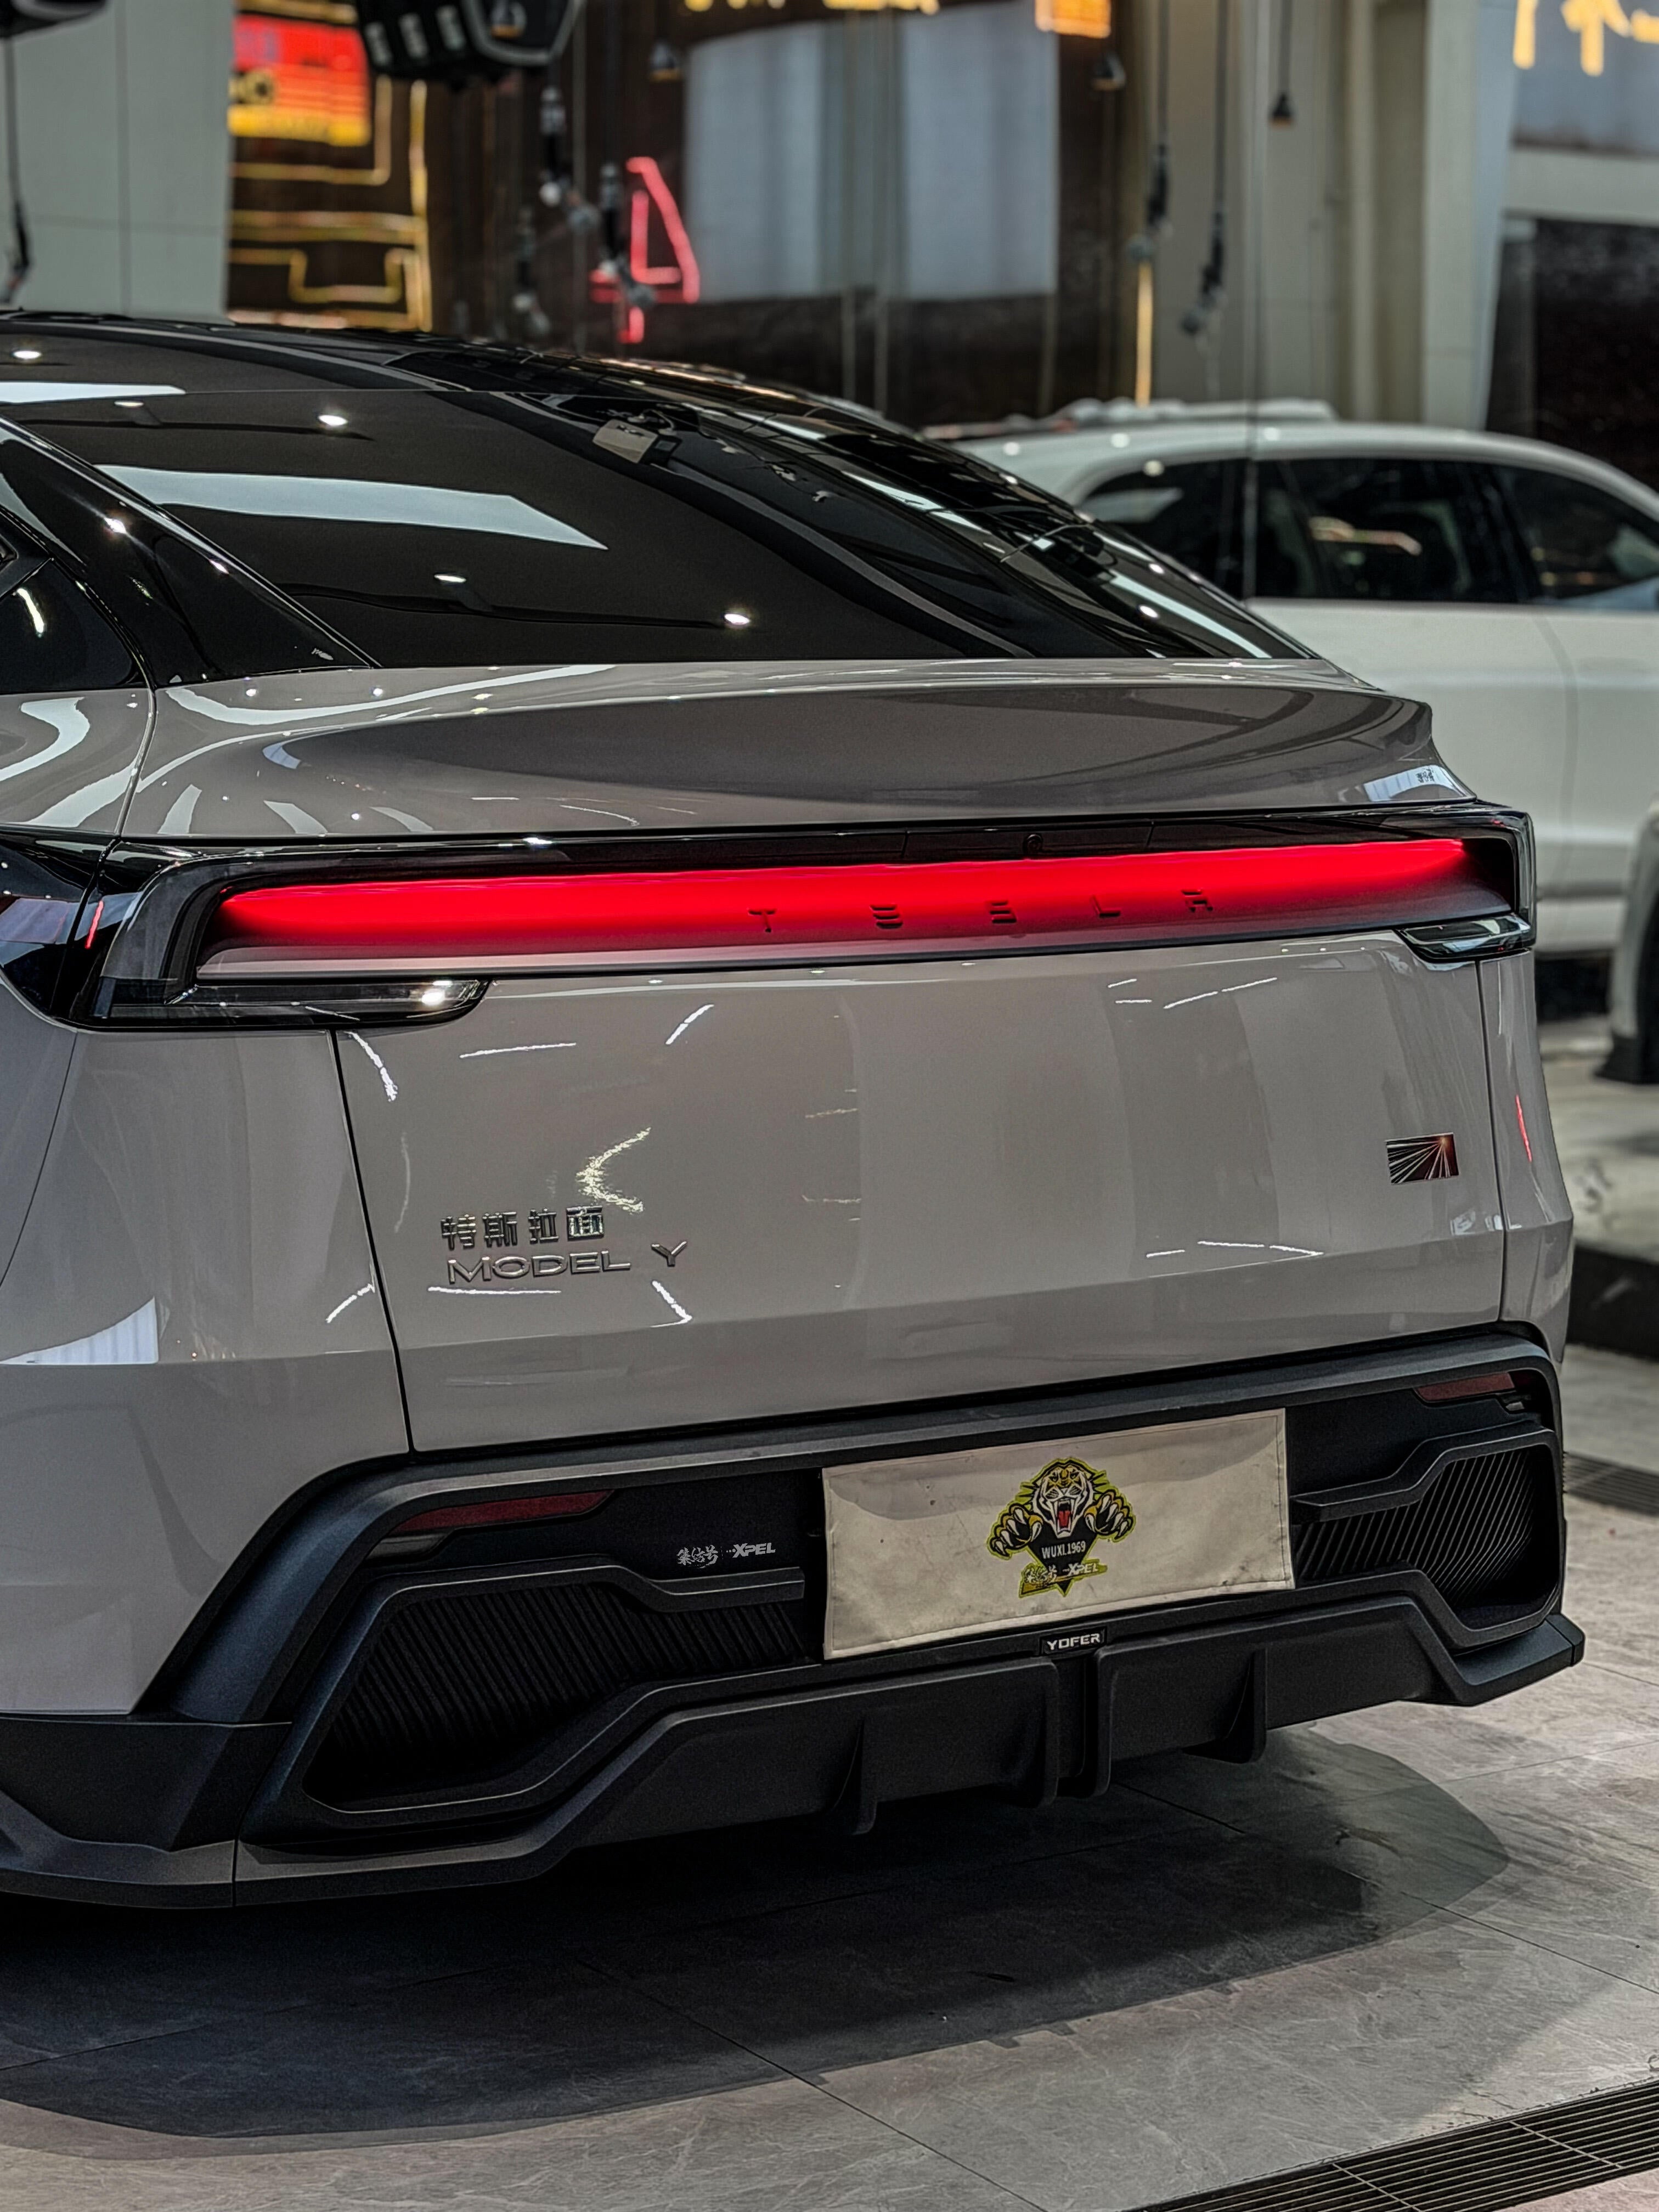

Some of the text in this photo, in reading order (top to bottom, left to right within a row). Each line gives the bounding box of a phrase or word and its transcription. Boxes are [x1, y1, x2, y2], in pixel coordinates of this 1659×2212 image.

[747, 888, 1214, 933] TESLA
[448, 1240, 687, 1284] MODEL Y
[732, 1543, 776, 1558] XPEL
[1047, 1633, 1101, 1650] YOFER
